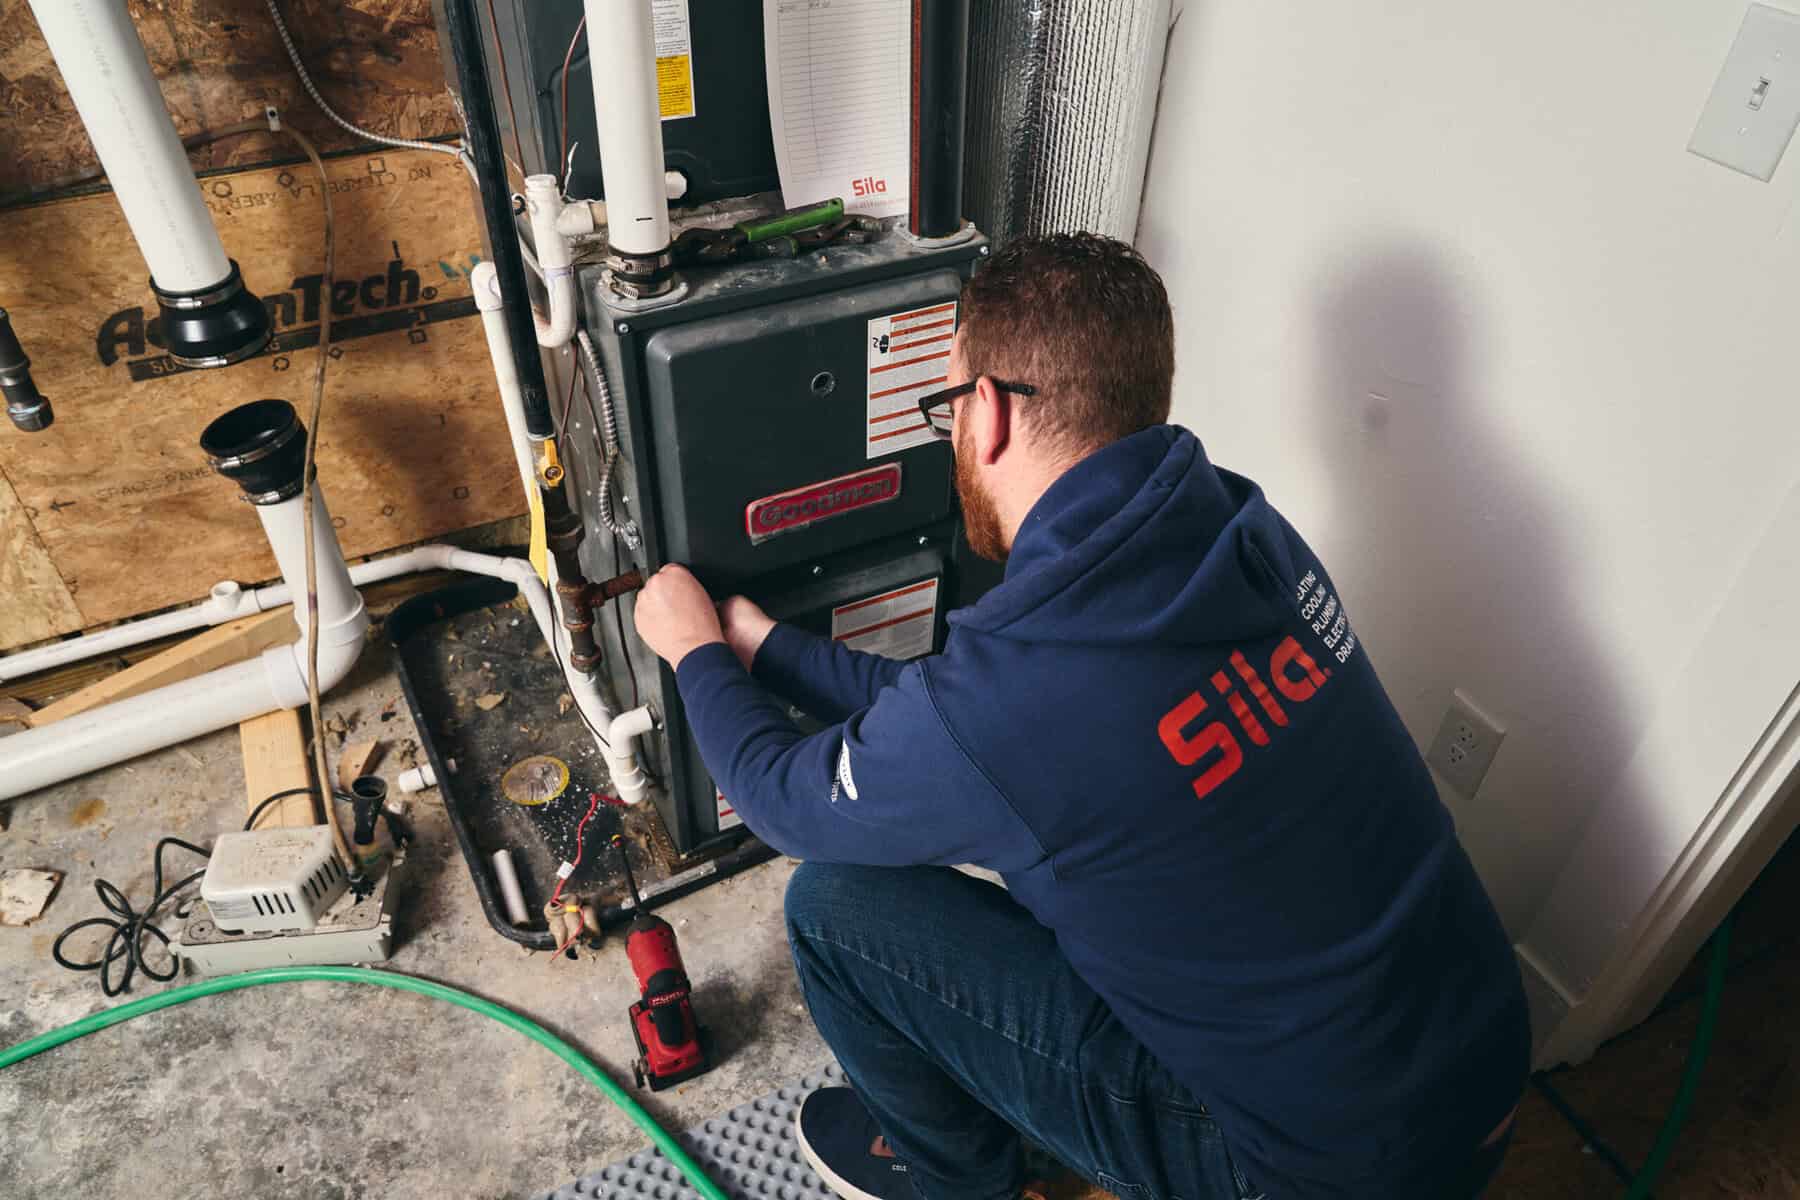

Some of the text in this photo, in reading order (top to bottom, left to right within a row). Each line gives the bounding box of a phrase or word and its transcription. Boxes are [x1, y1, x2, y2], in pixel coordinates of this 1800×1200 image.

[852, 177, 887, 196] Sila
[760, 479, 891, 527] Goodman
[1296, 570, 1317, 601] EATING
[1158, 635, 1328, 800] Sila
